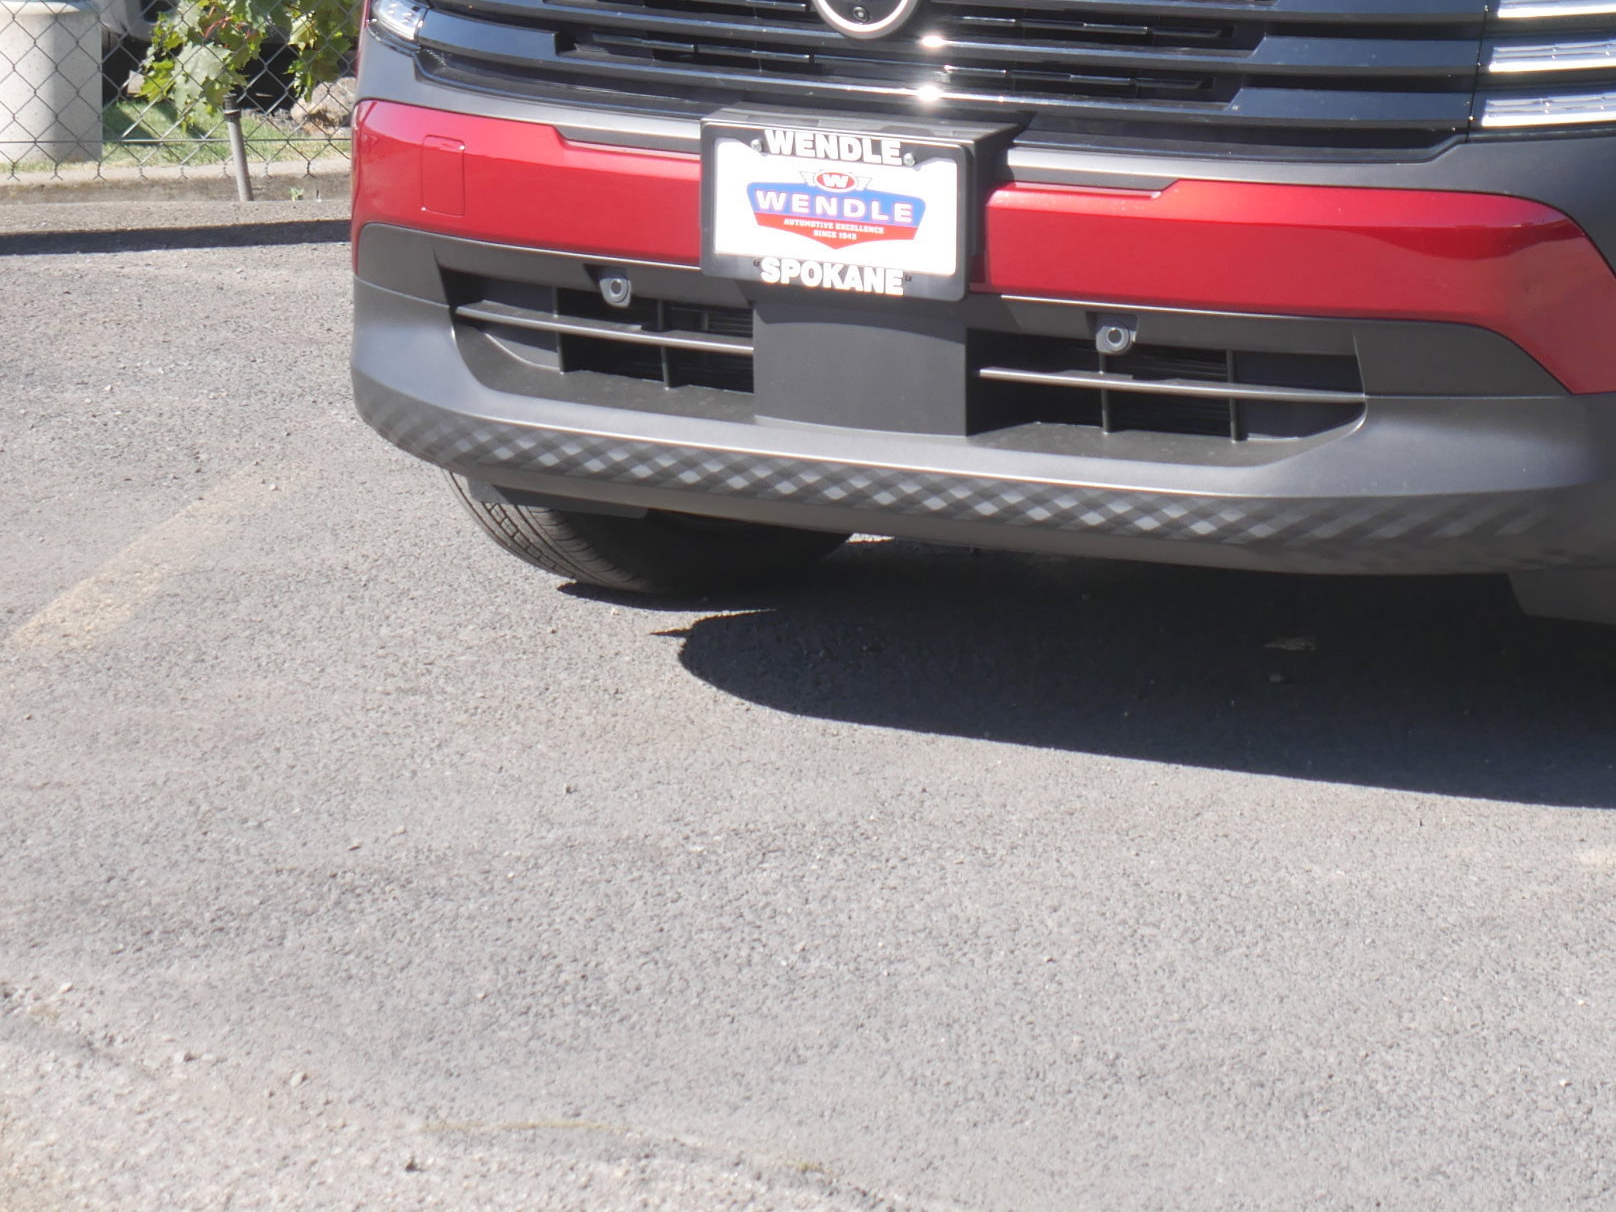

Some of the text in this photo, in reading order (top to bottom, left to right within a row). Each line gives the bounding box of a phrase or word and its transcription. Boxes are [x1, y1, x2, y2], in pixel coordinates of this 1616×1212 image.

[764, 129, 902, 166] WENDLE
[755, 190, 913, 223] WENDLE
[784, 219, 884, 234] AUTOMOTIVE EXCELLENCE
[760, 257, 904, 296] SPOKANE
